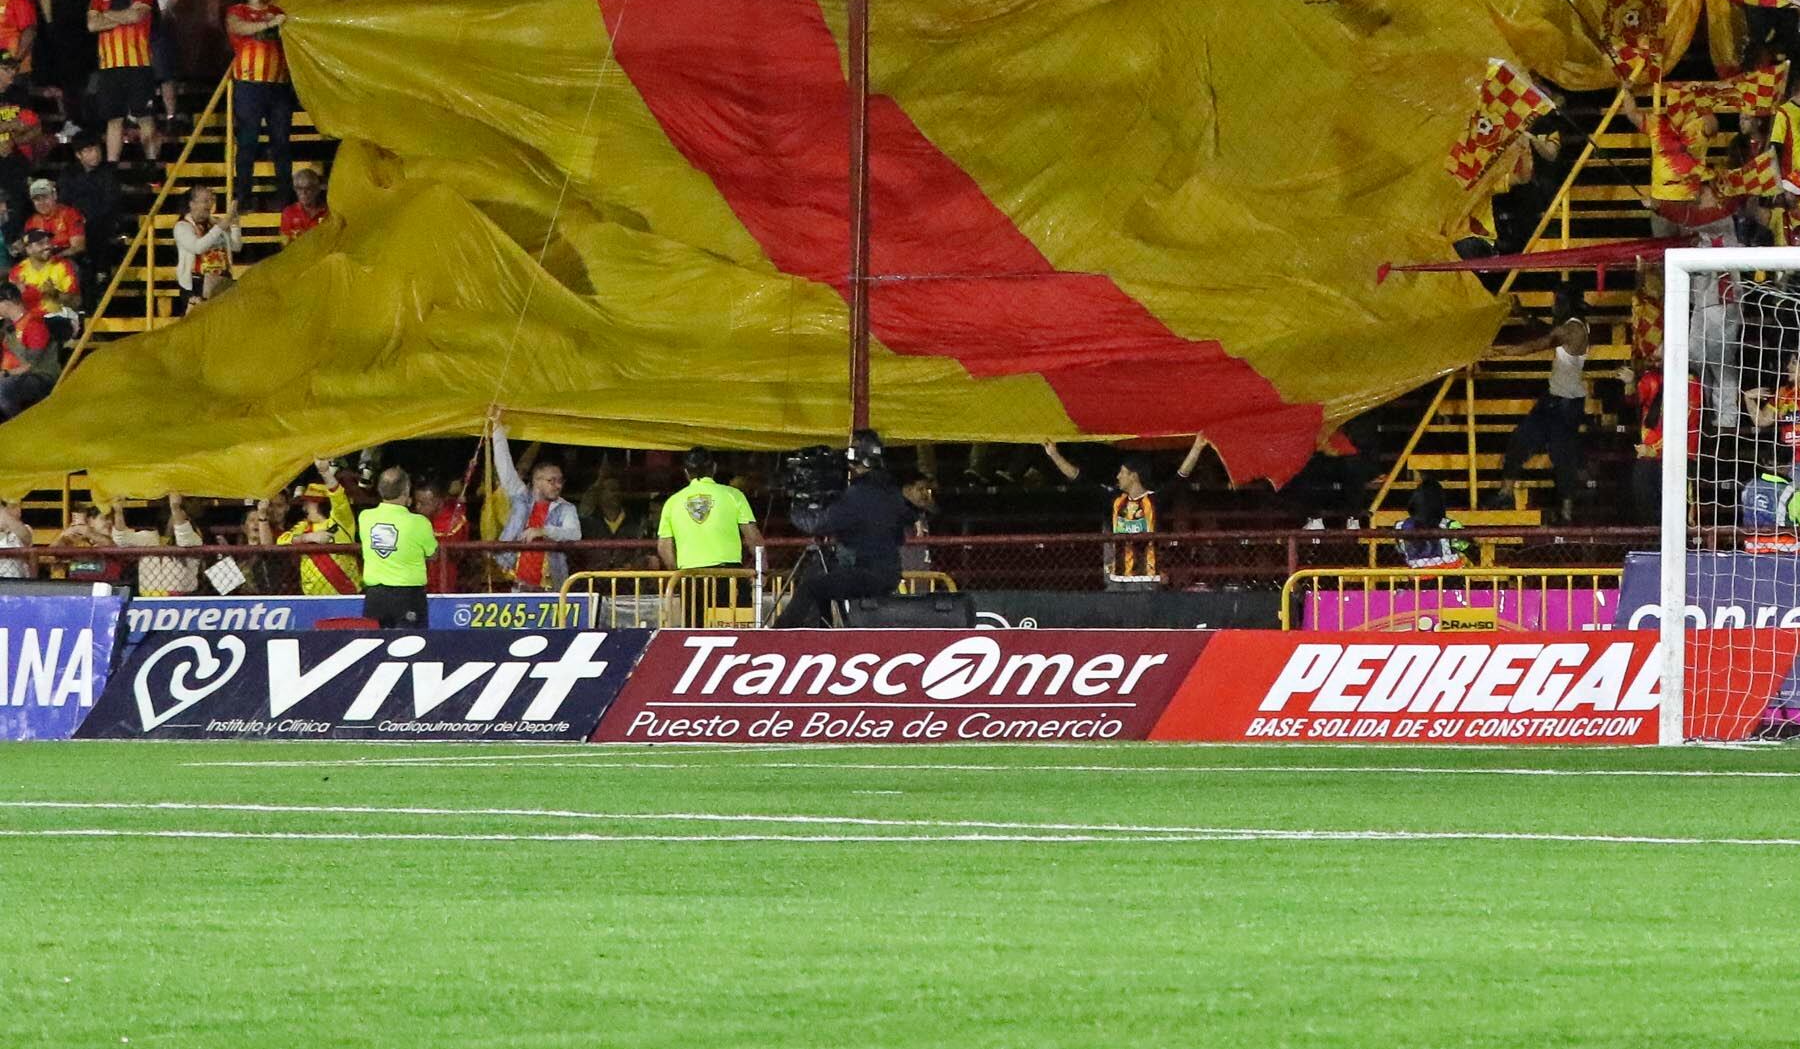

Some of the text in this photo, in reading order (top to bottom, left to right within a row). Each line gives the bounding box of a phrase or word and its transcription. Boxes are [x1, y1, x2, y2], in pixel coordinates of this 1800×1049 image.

[0, 627, 94, 706] NA
[267, 632, 609, 720] Vivit
[206, 718, 331, 736] Instituto y Clínica
[378, 720, 570, 736] Cardiopulmonar y del Deporte
[626, 710, 1123, 739] Puesto de Bolsa de Comercio
[1246, 717, 1643, 738] BASE SOLIDA DE SU CONSTRUCCION
